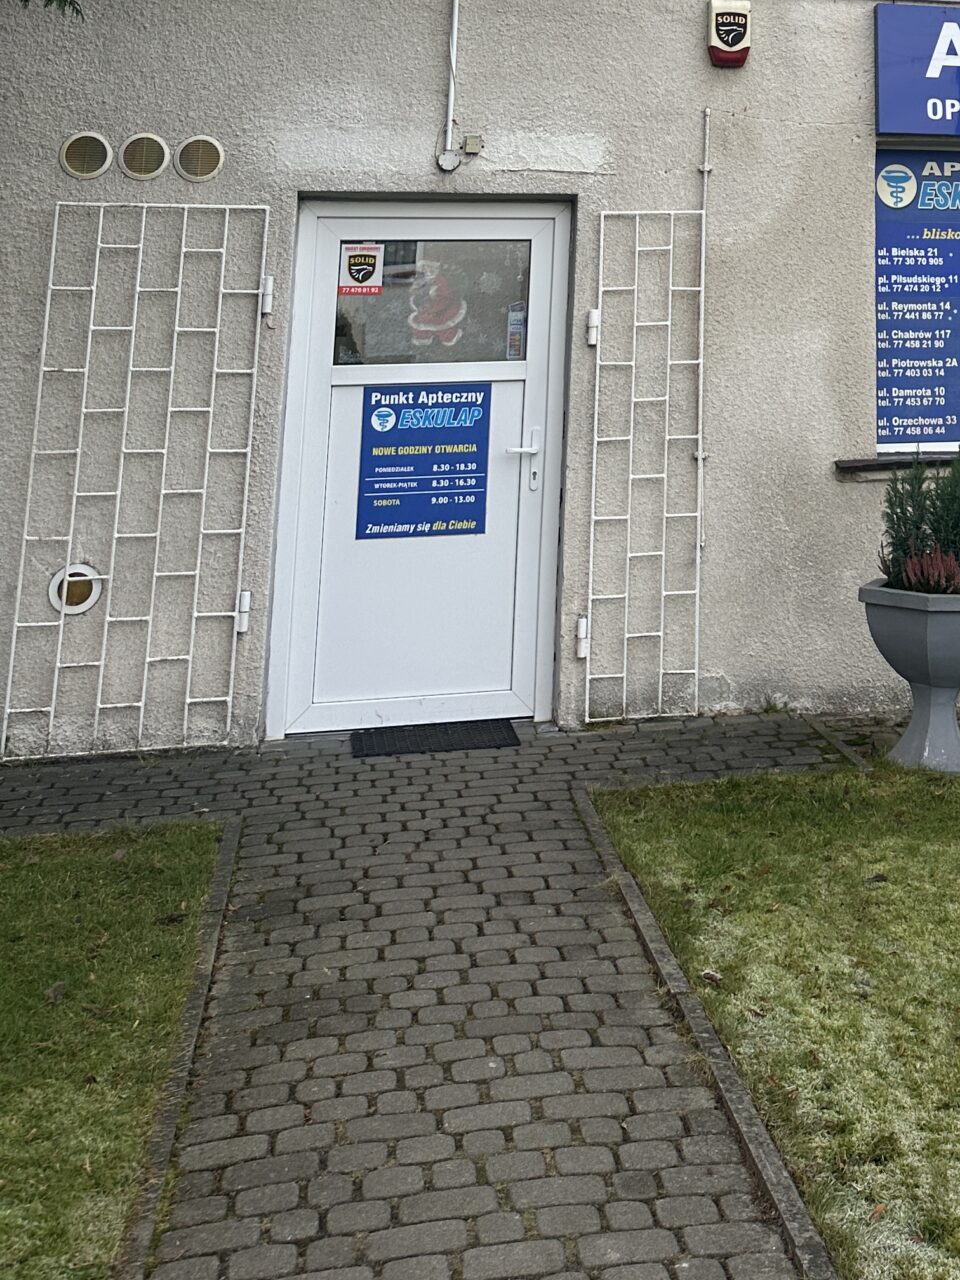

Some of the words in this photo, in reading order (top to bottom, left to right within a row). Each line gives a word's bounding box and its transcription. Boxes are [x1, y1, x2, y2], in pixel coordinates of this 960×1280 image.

[717, 15, 746, 24] SOLID
[892, 248, 924, 256] Bielska
[928, 248, 937, 256] 21
[878, 275, 888, 285] pl.
[891, 275, 947, 286] Piłsudskiego
[949, 275, 957, 283] 11
[878, 284, 890, 292] tel.
[878, 302, 888, 310] ul.
[892, 302, 938, 313] Reymonta
[940, 302, 950, 310] 14
[904, 311, 919, 319] 441
[878, 330, 889, 338] ul.
[892, 330, 932, 338] Chabrów
[935, 330, 951, 338] 117
[893, 340, 903, 348] 77
[905, 340, 920, 348] 458
[878, 359, 889, 367] ul.
[892, 359, 943, 367] Piotrowska
[946, 358, 958, 366] 2A
[878, 388, 889, 396] ul.
[892, 388, 931, 396] Damrota
[934, 387, 945, 395] 10
[371, 392, 414, 405] Punkt
[418, 391, 484, 406] Apteczny
[894, 398, 903, 406] 77
[935, 397, 945, 405] 70
[398, 407, 483, 429] ESKULAP
[878, 417, 889, 426] ul.
[892, 417, 943, 425] Orzechowa
[946, 416, 957, 424] 33
[878, 428, 891, 436] tel.
[894, 427, 904, 435] 77
[372, 447, 397, 456] NOWE
[398, 445, 433, 455] GODZINY
[435, 444, 477, 454] OTWARCIA
[456, 463, 477, 471] 18.30
[455, 478, 476, 486] 16.30
[373, 499, 400, 507] SOBOTA
[454, 495, 475, 503] 13.00
[365, 523, 415, 534] Zmieniamy
[417, 522, 430, 533] się
[433, 521, 446, 530] dla
[449, 519, 476, 529] Ciebie
